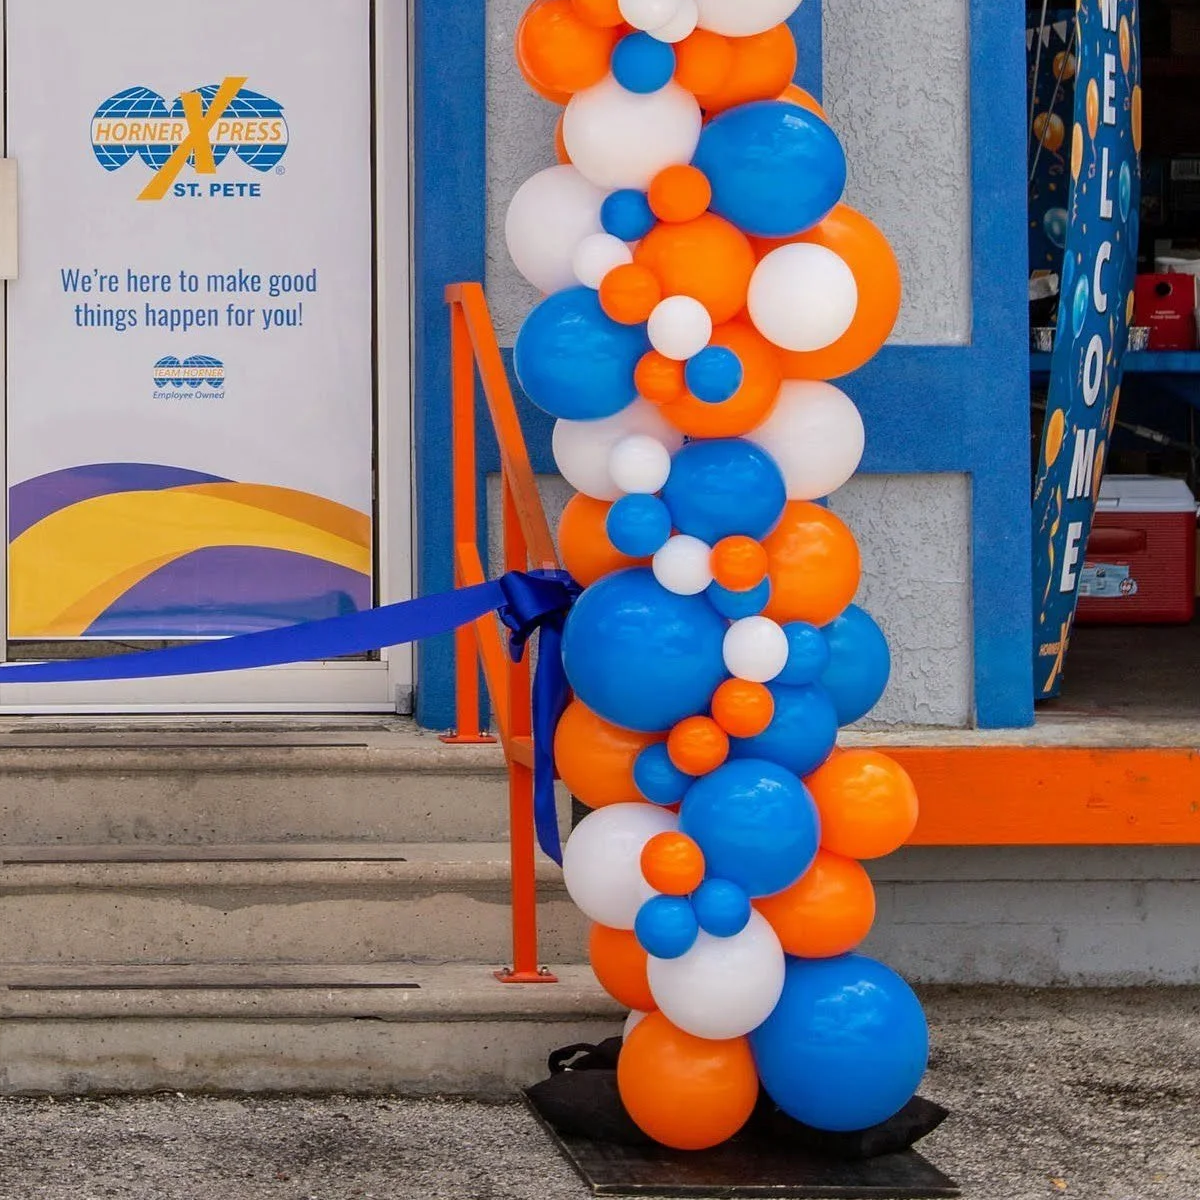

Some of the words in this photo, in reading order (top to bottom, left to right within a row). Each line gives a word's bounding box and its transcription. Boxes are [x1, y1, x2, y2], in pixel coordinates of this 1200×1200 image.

[173, 183, 202, 197] ST.
[210, 183, 261, 197] PETE
[61, 268, 119, 292] We’re
[127, 269, 172, 292] here
[179, 272, 199, 292] to
[207, 268, 262, 292] make
[269, 268, 317, 297] good
[75, 303, 138, 331] things
[145, 303, 219, 331] happen
[226, 303, 256, 327] for
[262, 302, 303, 330] you!
[153, 390, 194, 400] Employee
[195, 391, 225, 399] Owned
